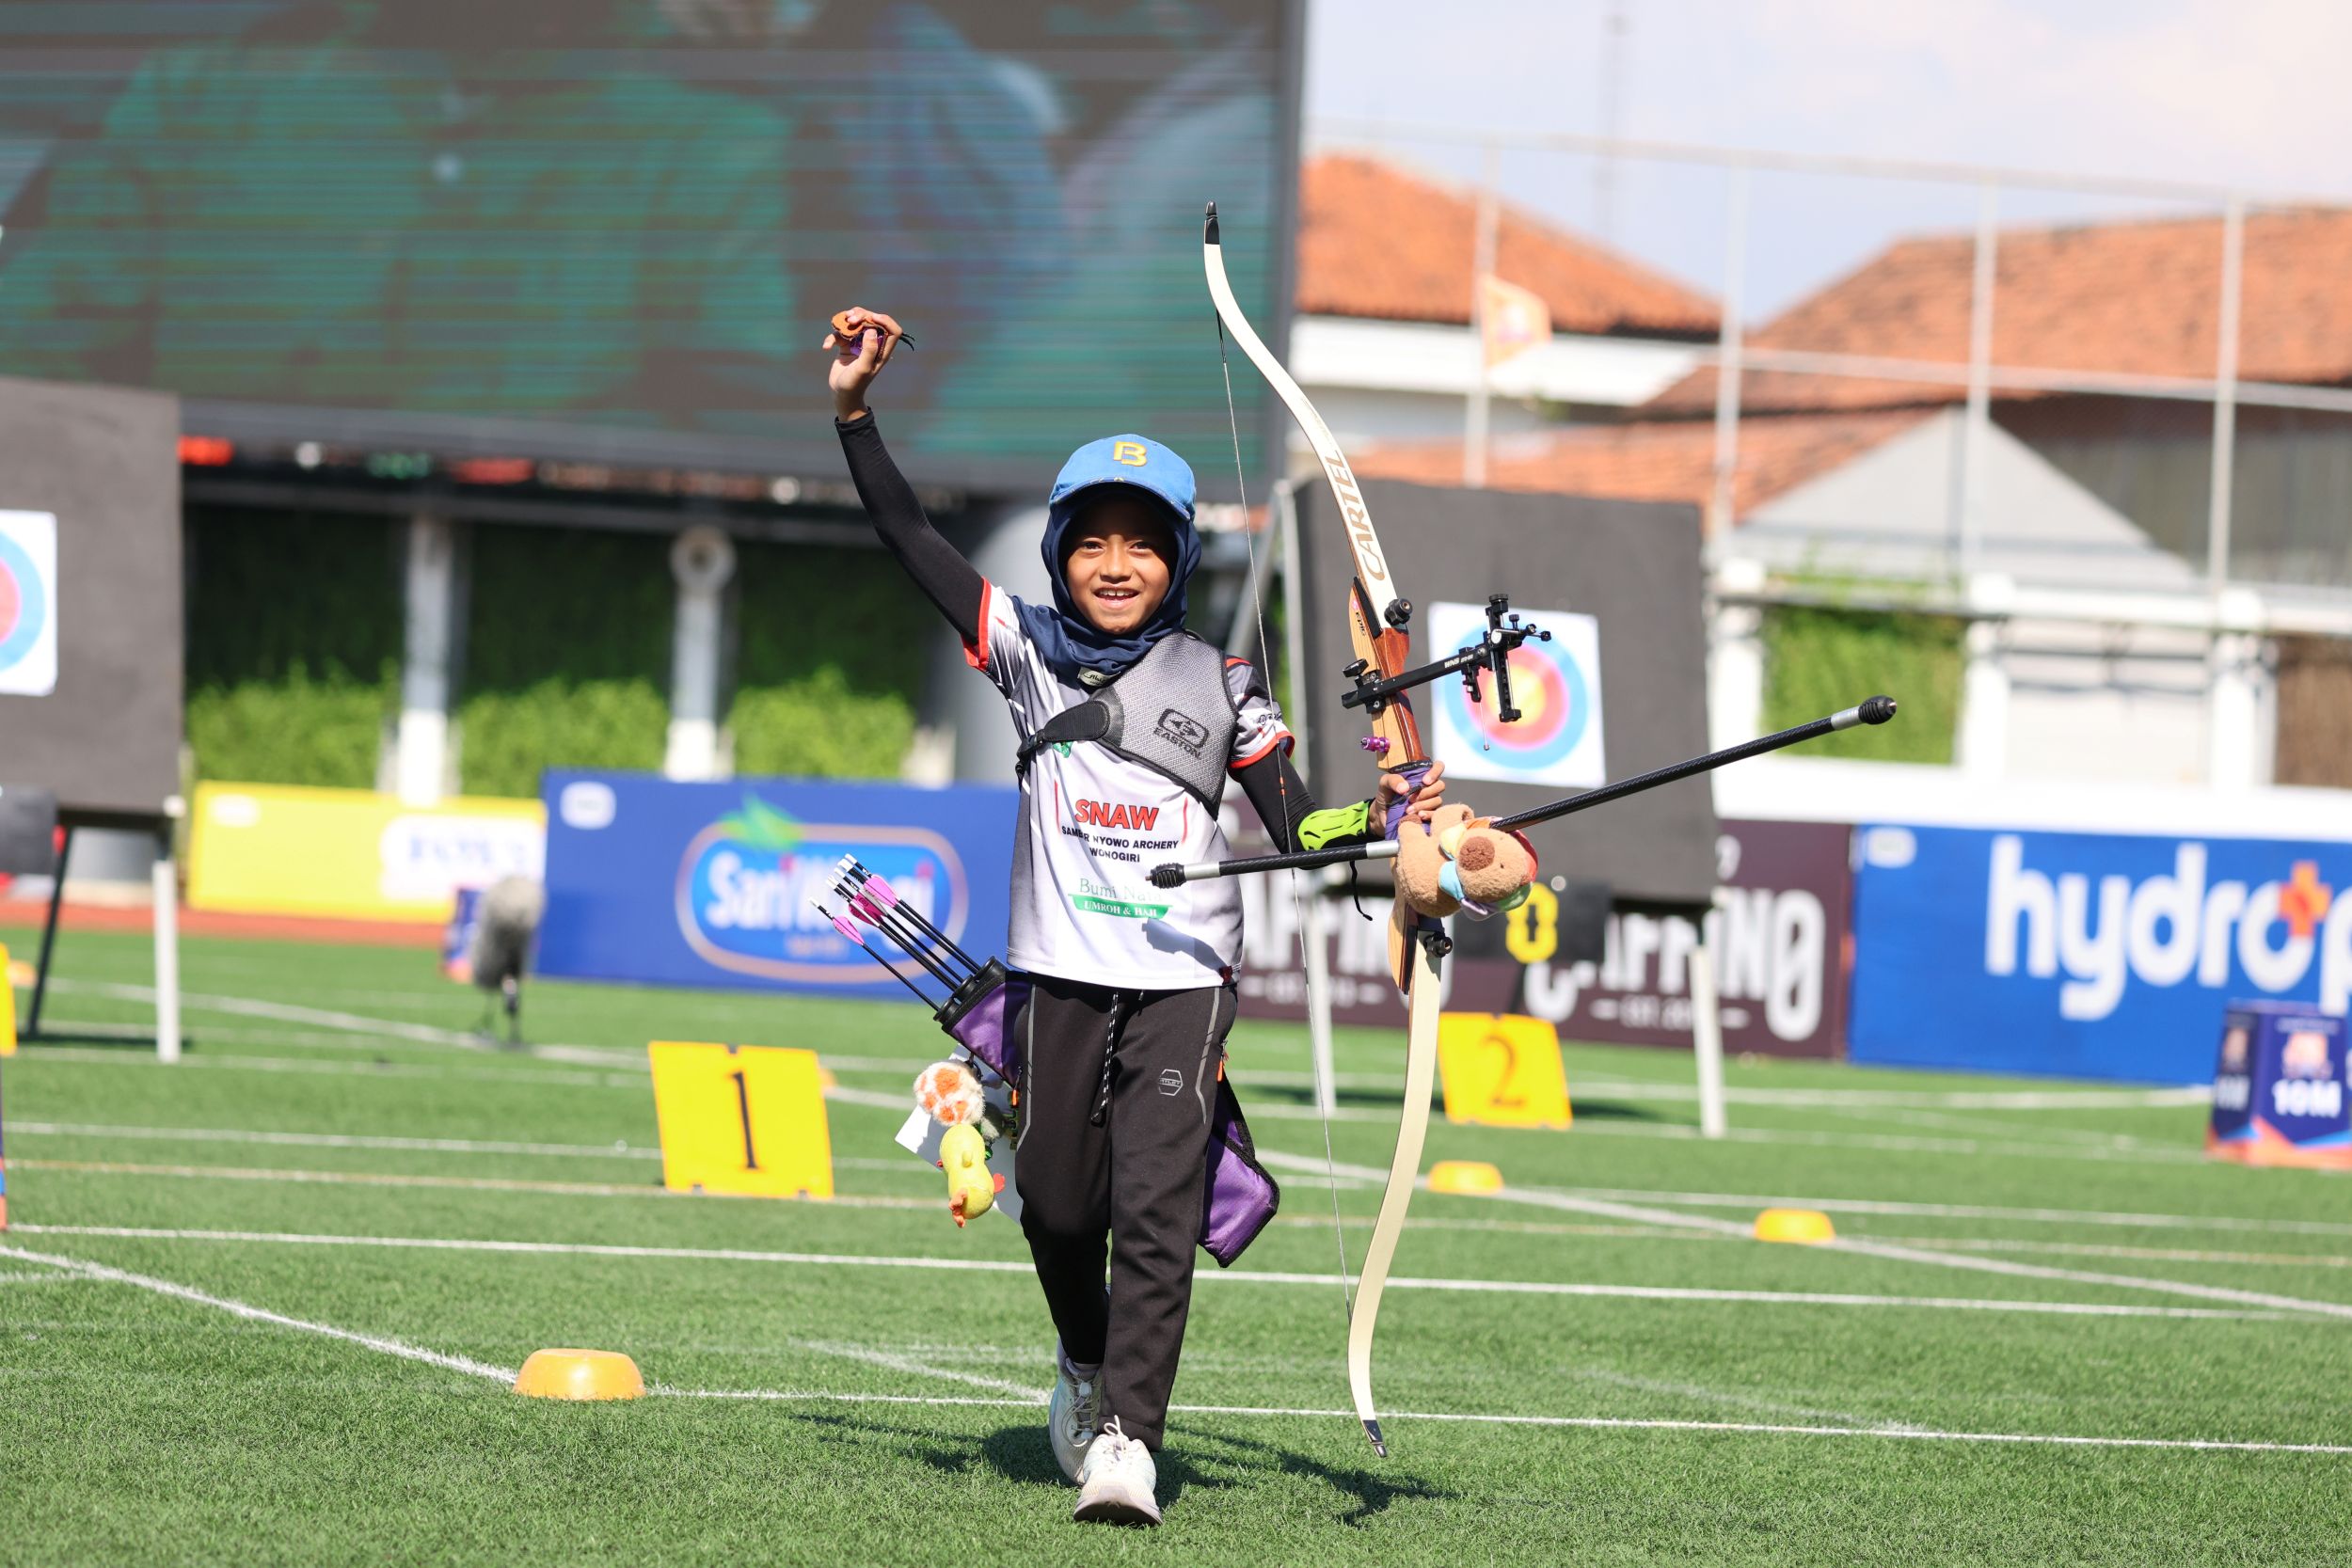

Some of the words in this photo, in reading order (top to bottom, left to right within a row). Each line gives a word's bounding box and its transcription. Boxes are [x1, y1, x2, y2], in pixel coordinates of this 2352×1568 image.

[1113, 440, 1148, 467] B
[1324, 450, 1386, 581] CARTEL
[1153, 727, 1202, 760] EASTON
[1074, 799, 1159, 831] SNAW
[1089, 847, 1140, 863] WONOGIRI
[1092, 835, 1129, 847] NYOWO
[1132, 840, 1179, 849] ARCHERY
[1079, 878, 1117, 898] Bumi
[1084, 900, 1120, 914] UMROH
[1122, 907, 1131, 915] &
[1480, 1033, 1526, 1109] 2
[729, 1070, 758, 1169] 1
